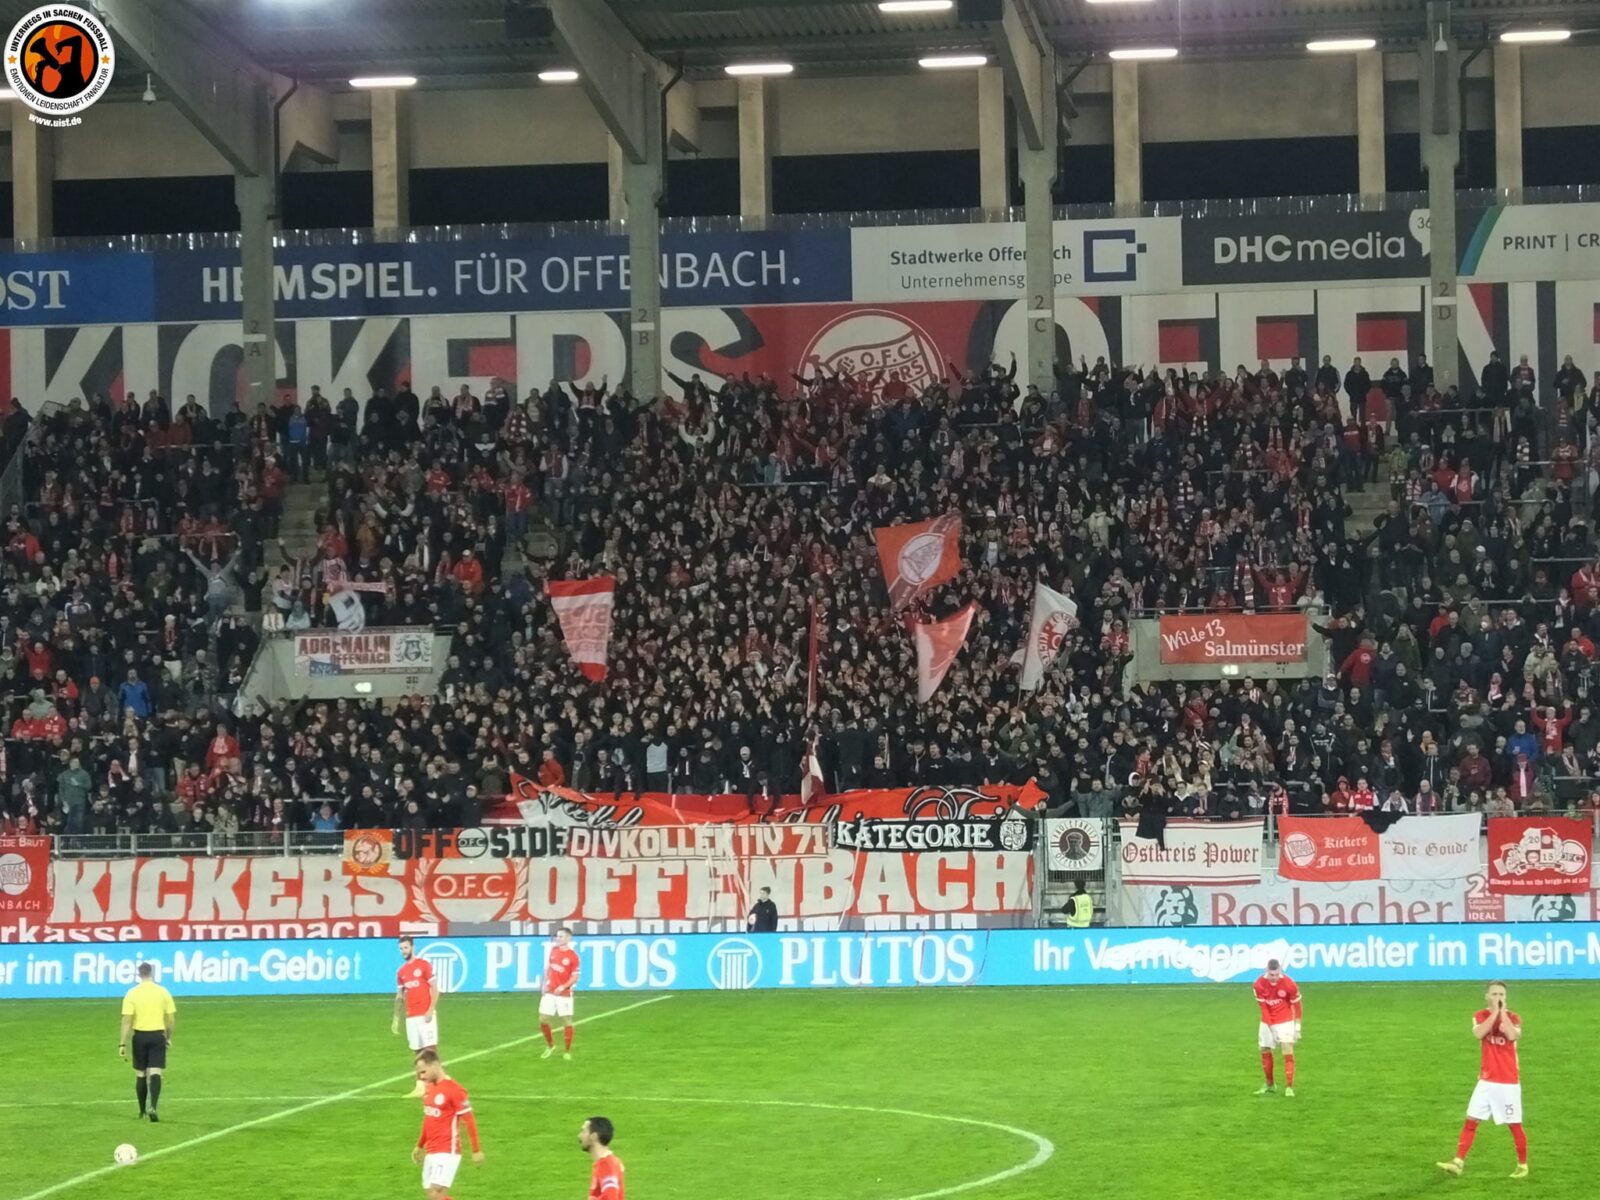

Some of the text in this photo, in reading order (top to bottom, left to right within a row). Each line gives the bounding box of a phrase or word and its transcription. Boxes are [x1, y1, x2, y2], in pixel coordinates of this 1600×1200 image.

[890, 244, 1071, 265] Stadtwerke Offech
[1503, 235, 1557, 250] PRINT
[455, 252, 528, 295] FÜR
[541, 249, 800, 293] OFFEBACH.
[901, 272, 1072, 290] Unternehmensgpe
[860, 344, 916, 367] O.F.C.
[299, 635, 391, 655] ADRENALIN
[1162, 619, 1226, 652] Wilde 13
[1205, 640, 1305, 657] Salmünster
[789, 824, 828, 855] 71
[836, 821, 995, 849] KATEGORIE
[1324, 836, 1368, 849] Kickers
[1122, 842, 1259, 867] Ostkreis Power
[1316, 854, 1375, 868] Fan Club
[51, 850, 1033, 923] KICKERS O.F.C. OFFENBACH
[1212, 886, 1453, 925] Rosbacher
[1468, 912, 1497, 920] IDEAL
[779, 934, 975, 986] PLUTOS
[1034, 937, 1076, 972] Ihr
[1428, 933, 1467, 966] im
[26, 953, 63, 985] im
